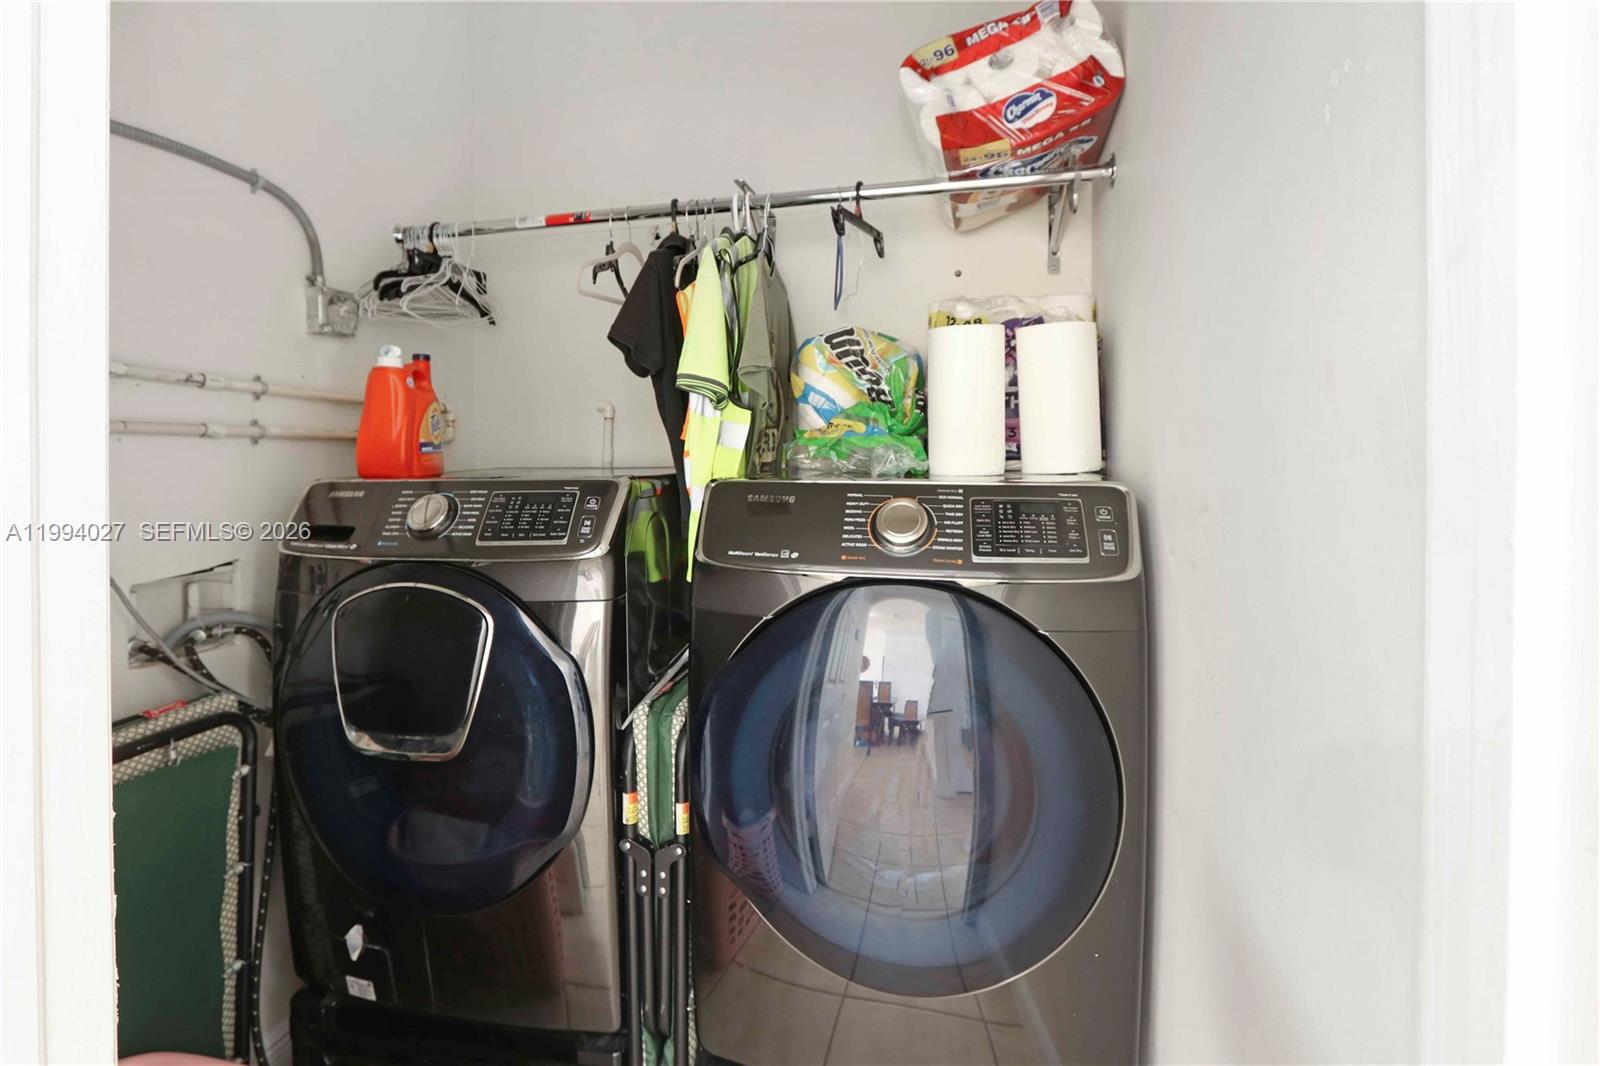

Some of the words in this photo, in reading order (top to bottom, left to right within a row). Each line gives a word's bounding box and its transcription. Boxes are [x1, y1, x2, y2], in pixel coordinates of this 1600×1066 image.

[966, 22, 1009, 47] MEGA
[1017, 132, 1064, 156] MEGA
[747, 494, 796, 504] SAMSUNG
